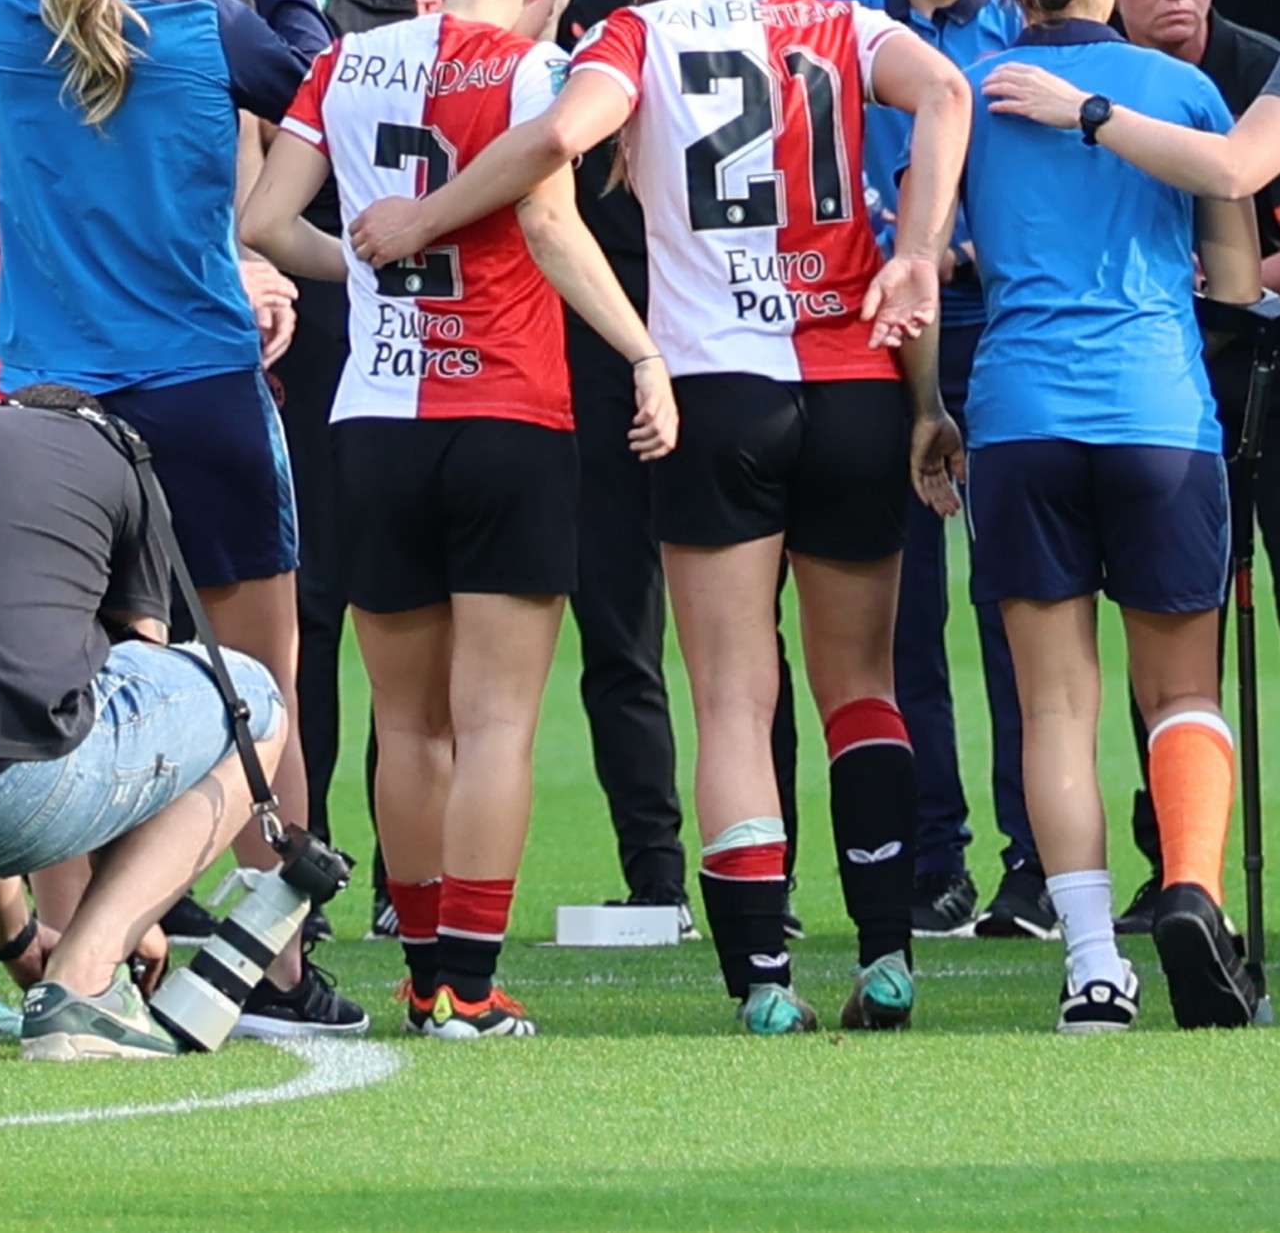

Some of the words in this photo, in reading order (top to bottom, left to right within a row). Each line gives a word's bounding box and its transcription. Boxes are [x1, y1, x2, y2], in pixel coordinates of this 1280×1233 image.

[337, 53, 518, 98] BRANDAU
[678, 44, 853, 231] 21
[373, 121, 464, 301] 2
[725, 248, 825, 286] Euro
[374, 302, 464, 341] Euro
[731, 289, 846, 324] Parcs
[369, 341, 481, 380] Parcs
